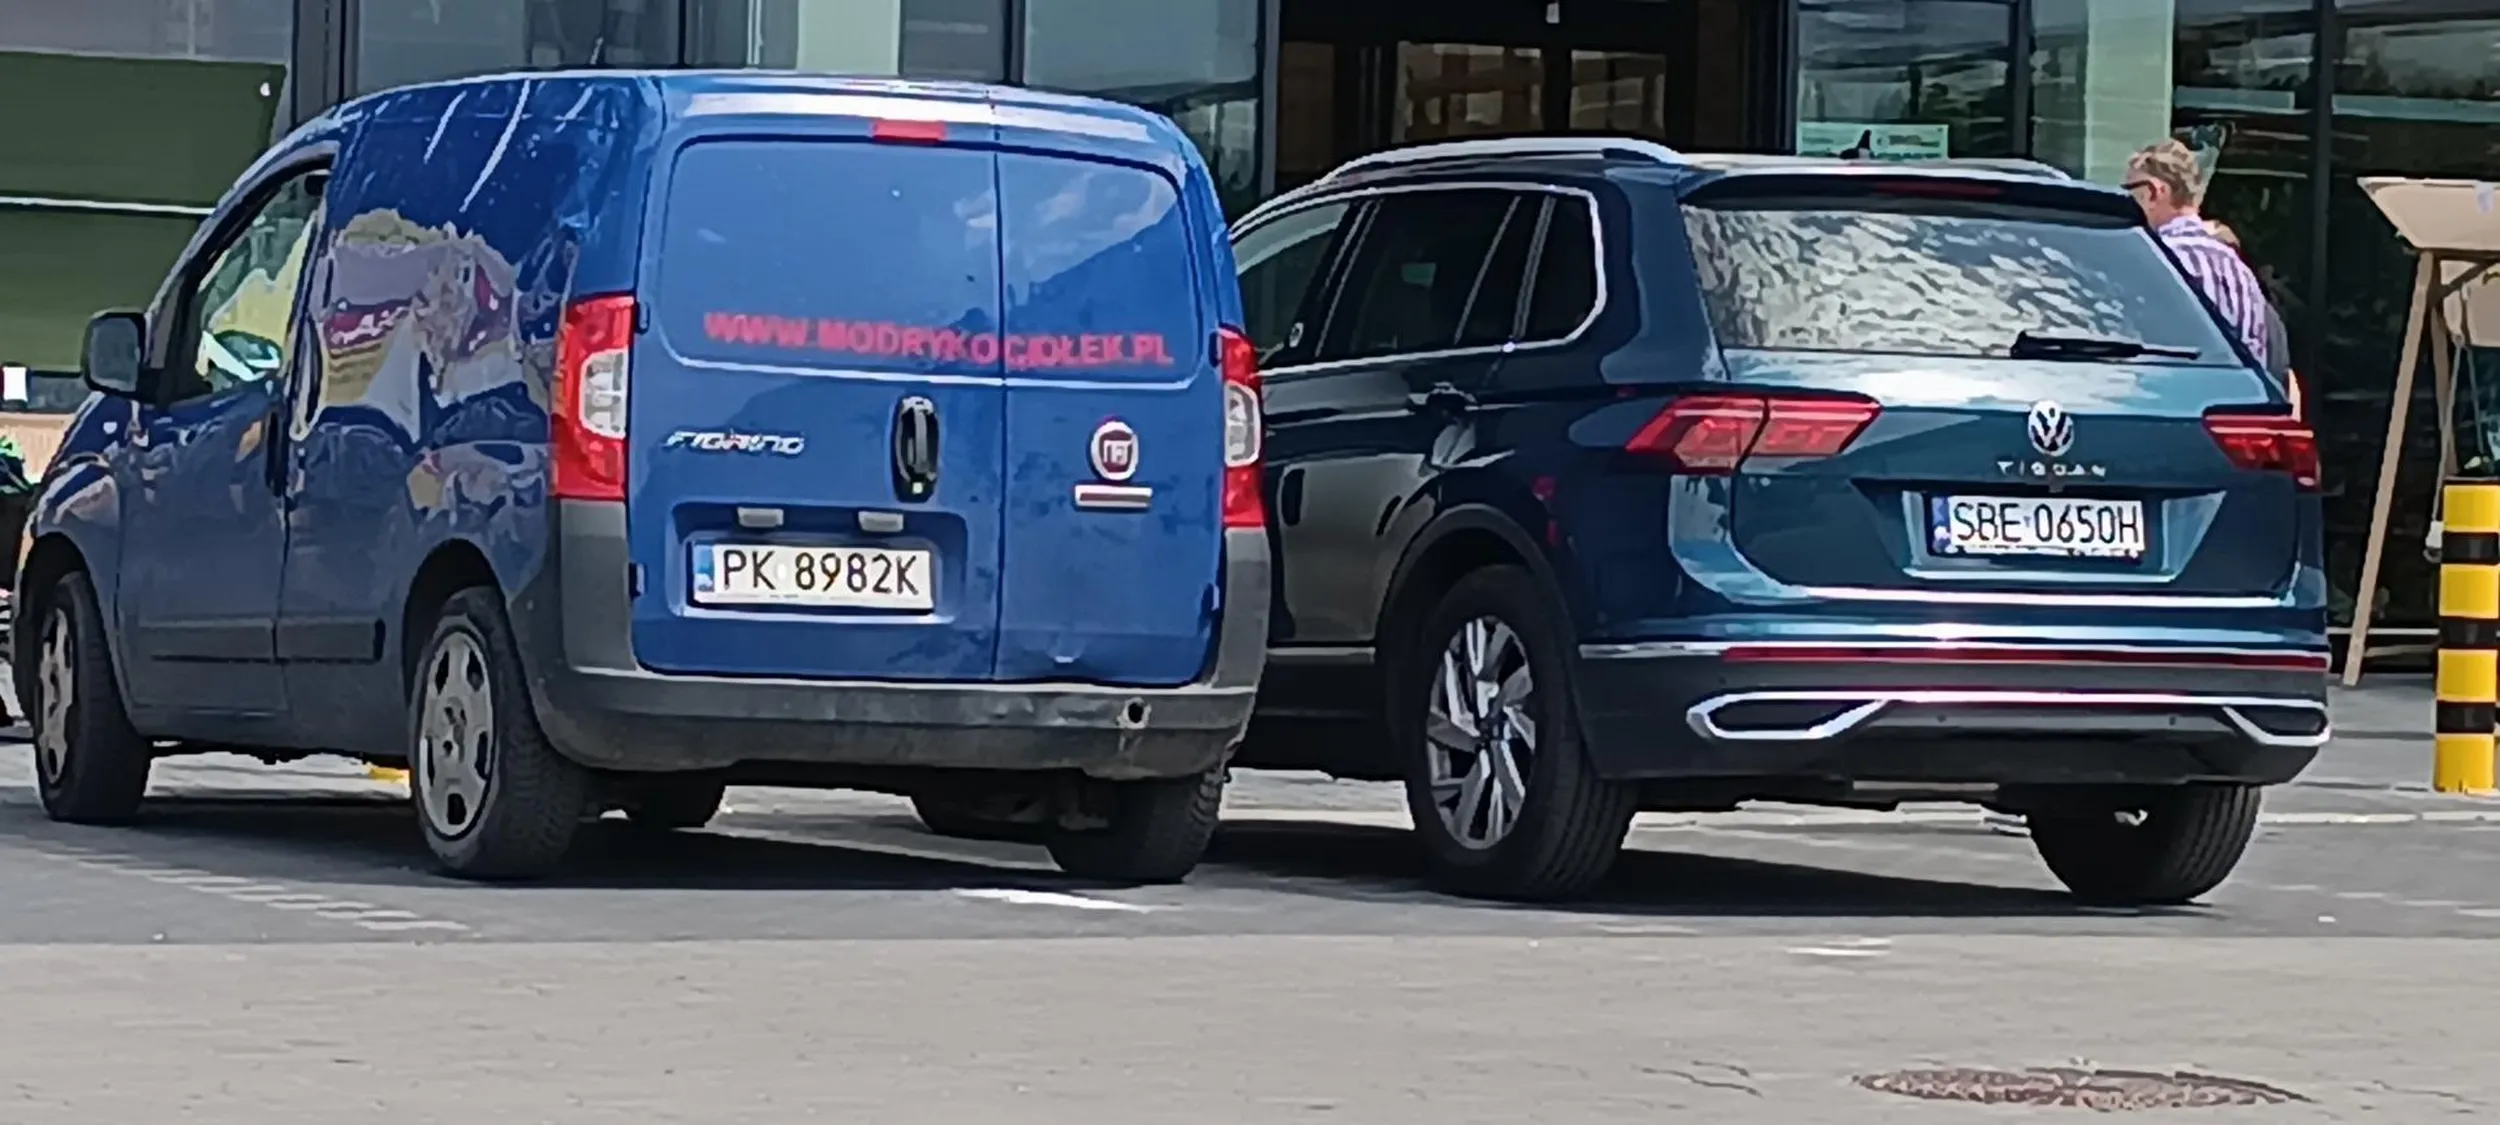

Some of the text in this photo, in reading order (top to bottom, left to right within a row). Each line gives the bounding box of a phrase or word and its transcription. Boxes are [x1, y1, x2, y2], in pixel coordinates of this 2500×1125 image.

[1953, 502, 2139, 544] SBE 0650H
[723, 549, 919, 595] PK 8982K
